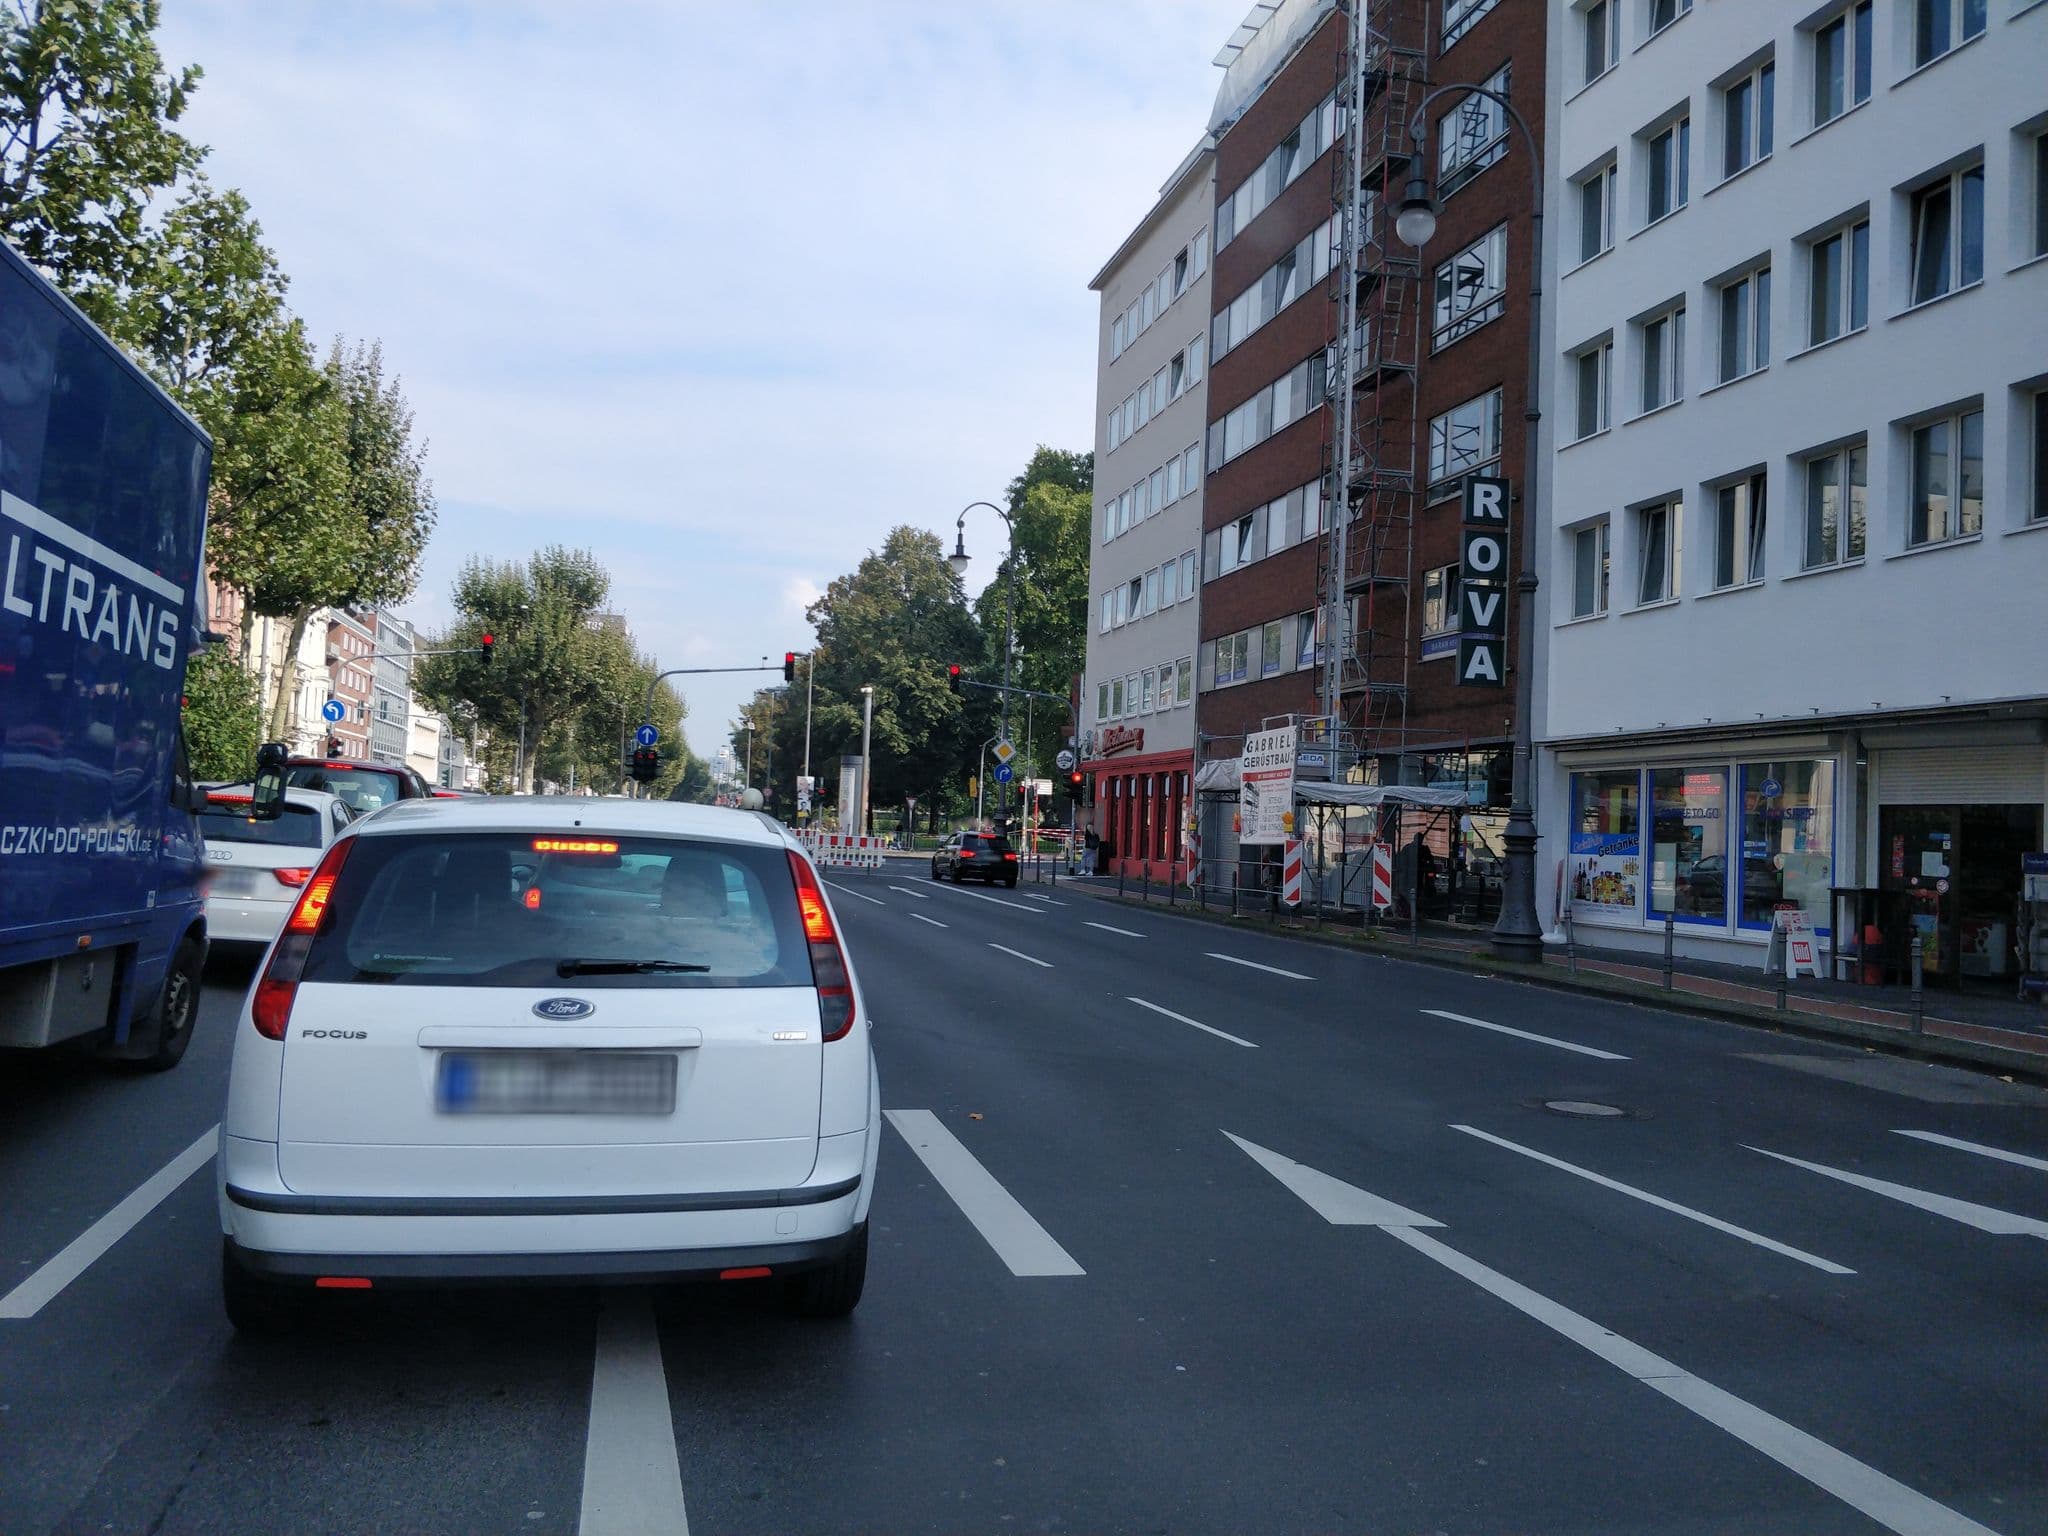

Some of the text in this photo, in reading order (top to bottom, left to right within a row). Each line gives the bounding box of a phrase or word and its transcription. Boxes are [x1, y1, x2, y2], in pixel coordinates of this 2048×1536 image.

[1463, 482, 1504, 681] ROVA
[3, 534, 179, 671] LTRANS
[1246, 734, 1291, 754] GABRIEL
[1243, 752, 1290, 768] GERÜSTBAU
[1598, 836, 1640, 858] Getränke
[1793, 943, 1811, 961] Bild
[547, 1000, 581, 1014] Ford
[302, 1029, 368, 1040] FOCUS
